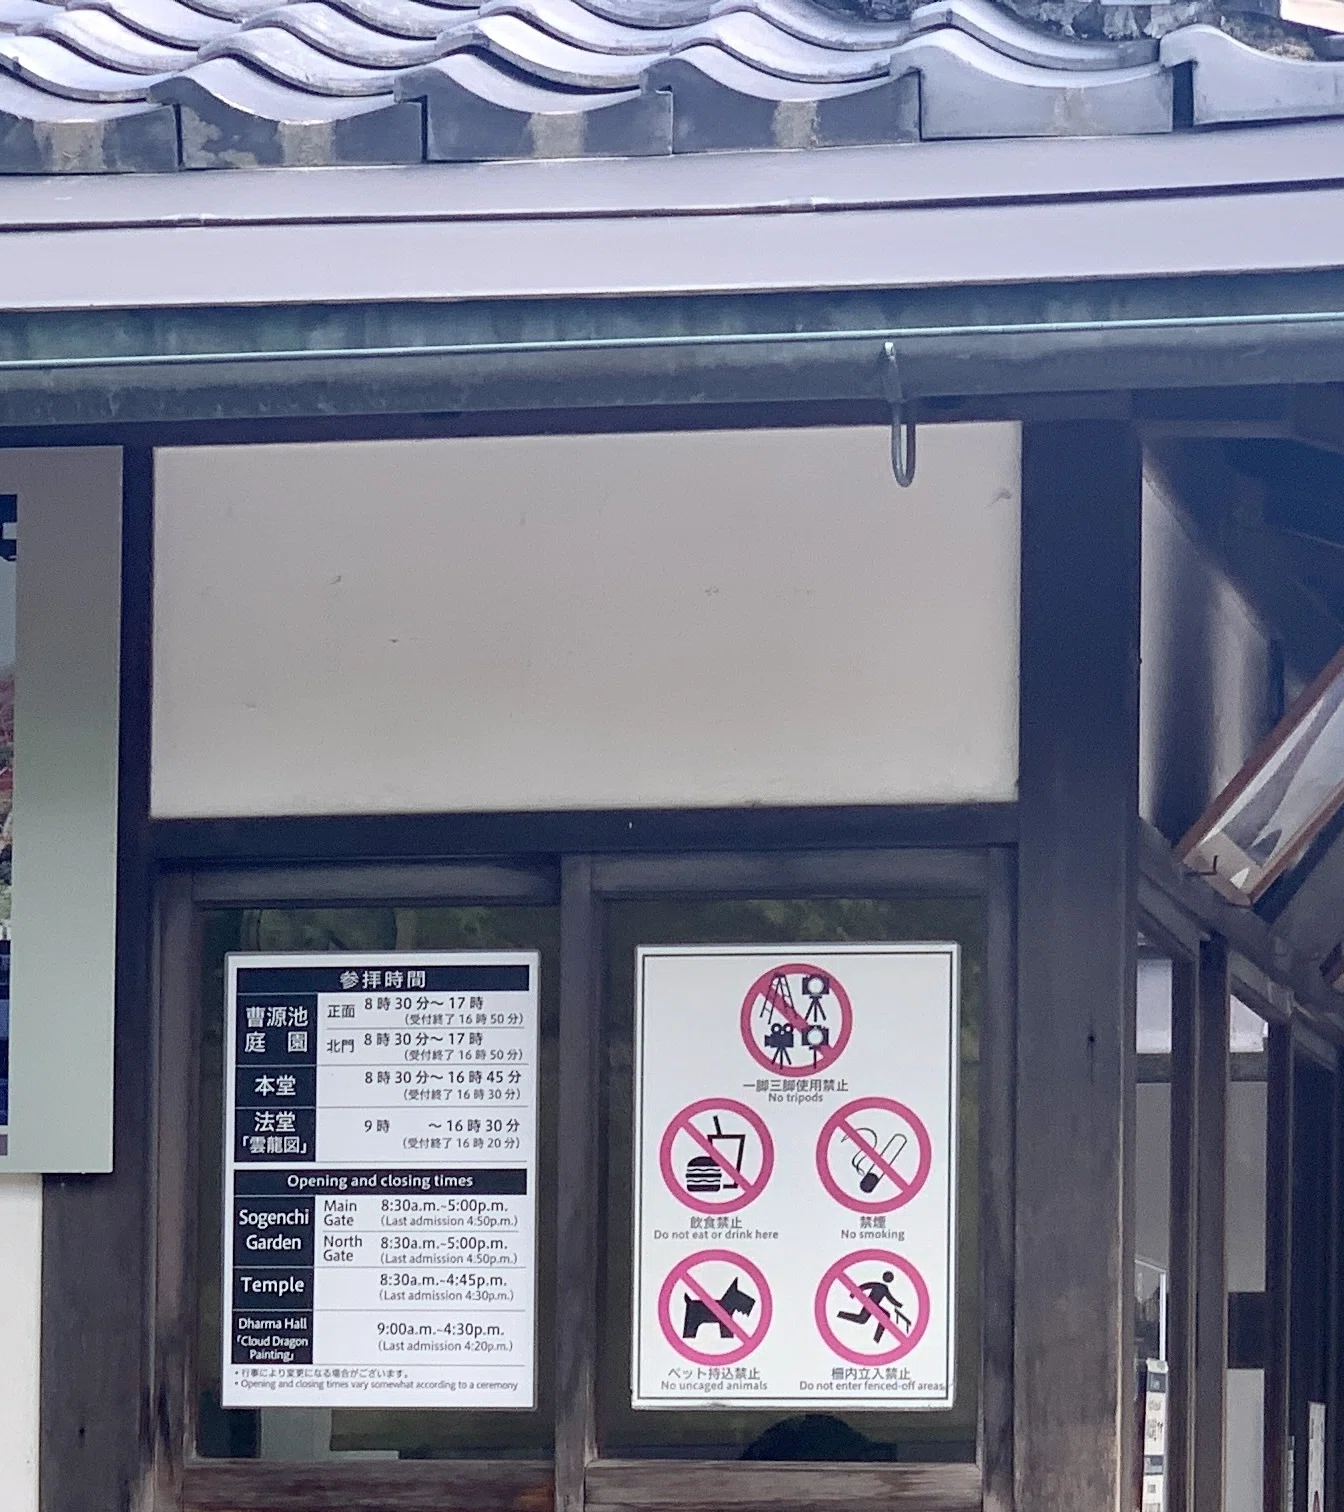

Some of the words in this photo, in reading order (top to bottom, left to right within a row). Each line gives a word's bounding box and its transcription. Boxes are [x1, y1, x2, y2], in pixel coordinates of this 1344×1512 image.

[339, 971, 426, 989] 参拝時間
[246, 1006, 308, 1027] 曹源池
[328, 1004, 355, 1018] 正面
[327, 1039, 355, 1053] 北門
[255, 1074, 296, 1096] 本堂
[743, 1079, 848, 1092] 一脚三脚使用禁止
[768, 1093, 783, 1102] No
[786, 1092, 823, 1104] tripods
[255, 1111, 296, 1132] 法堂
[289, 1174, 347, 1190] Opening
[351, 1174, 376, 1187] and
[380, 1174, 430, 1190] closing
[434, 1174, 473, 1187] times
[324, 1200, 357, 1212] Main
[239, 1209, 309, 1229] Sogenchi
[324, 1214, 355, 1227] Gate
[381, 1216, 408, 1227] (Last
[410, 1216, 464, 1226] admission
[690, 1216, 742, 1229] 飲食禁止
[860, 1216, 886, 1228] 禁煙
[654, 1230, 669, 1239] Do
[672, 1230, 690, 1239] not
[692, 1230, 709, 1239] eat
[725, 1230, 752, 1239] drink
[756, 1230, 779, 1239] here
[842, 1230, 855, 1239] No
[859, 1230, 905, 1241] smoking
[246, 1235, 301, 1250] Garden
[324, 1236, 363, 1248] North
[324, 1250, 353, 1263] Gate
[380, 1253, 408, 1265] (Last
[410, 1253, 463, 1264] admission
[242, 1276, 304, 1296] Temple
[379, 1290, 406, 1302] (Last
[408, 1290, 461, 1301] admission
[239, 1318, 282, 1330] Dharma
[285, 1318, 307, 1329] Hall
[272, 1336, 308, 1349] Dragon
[378, 1340, 405, 1352] (Last
[407, 1340, 460, 1351] admission
[241, 1380, 276, 1390] Opening
[278, 1380, 293, 1388] and
[296, 1380, 324, 1390] closing
[326, 1380, 349, 1389] times
[351, 1382, 369, 1391] vary
[371, 1381, 413, 1389] somewhat
[416, 1382, 456, 1391] according
[476, 1382, 518, 1391] ceremony
[662, 1381, 677, 1390] No
[680, 1380, 723, 1392] uncaged
[726, 1380, 768, 1390] animals
[800, 1381, 814, 1390] Do
[817, 1382, 833, 1390] not
[836, 1382, 861, 1390] enter
[864, 1380, 916, 1390] fenced-off
